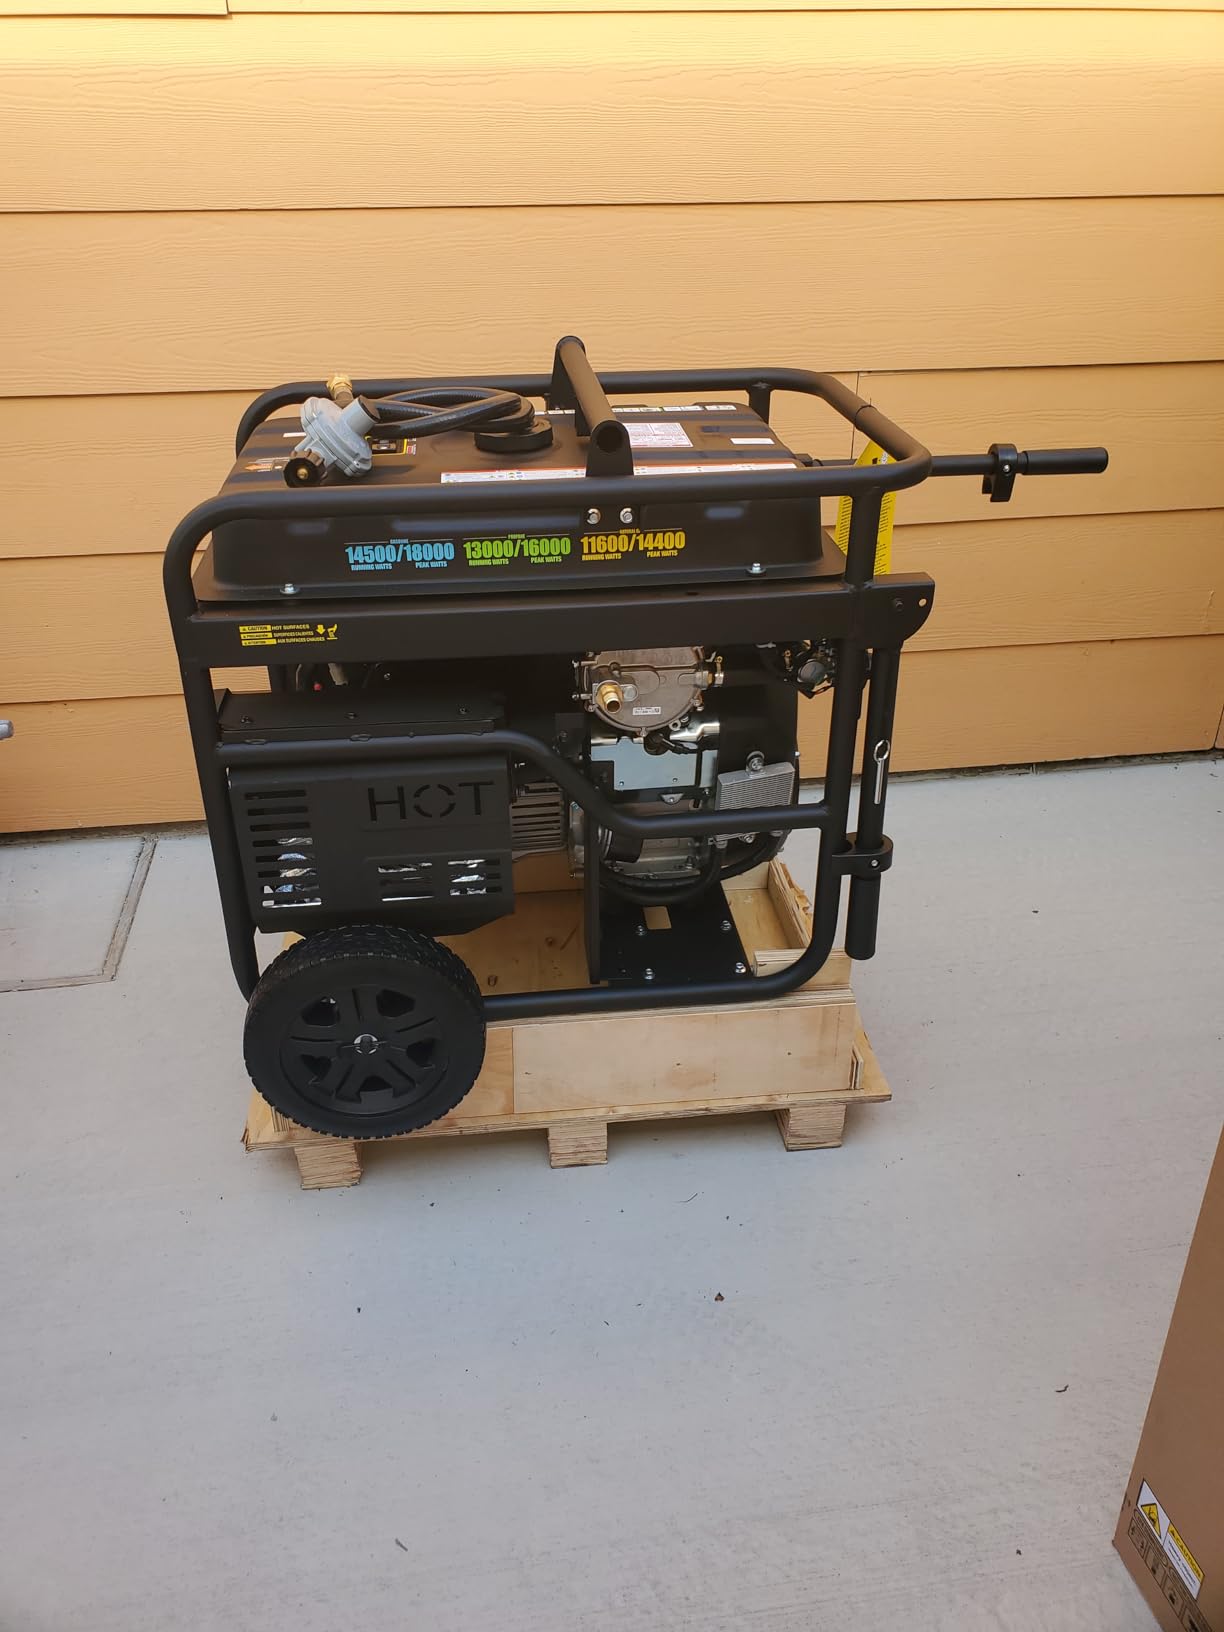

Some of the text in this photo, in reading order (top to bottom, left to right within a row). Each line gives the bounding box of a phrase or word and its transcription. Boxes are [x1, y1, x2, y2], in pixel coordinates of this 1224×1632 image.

[345, 542, 455, 563] 14500/18000
[463, 537, 571, 559] 13000/16000
[580, 531, 686, 553] 11600/14400
[661, 549, 678, 557] WATTS
[367, 781, 495, 821] HOT
